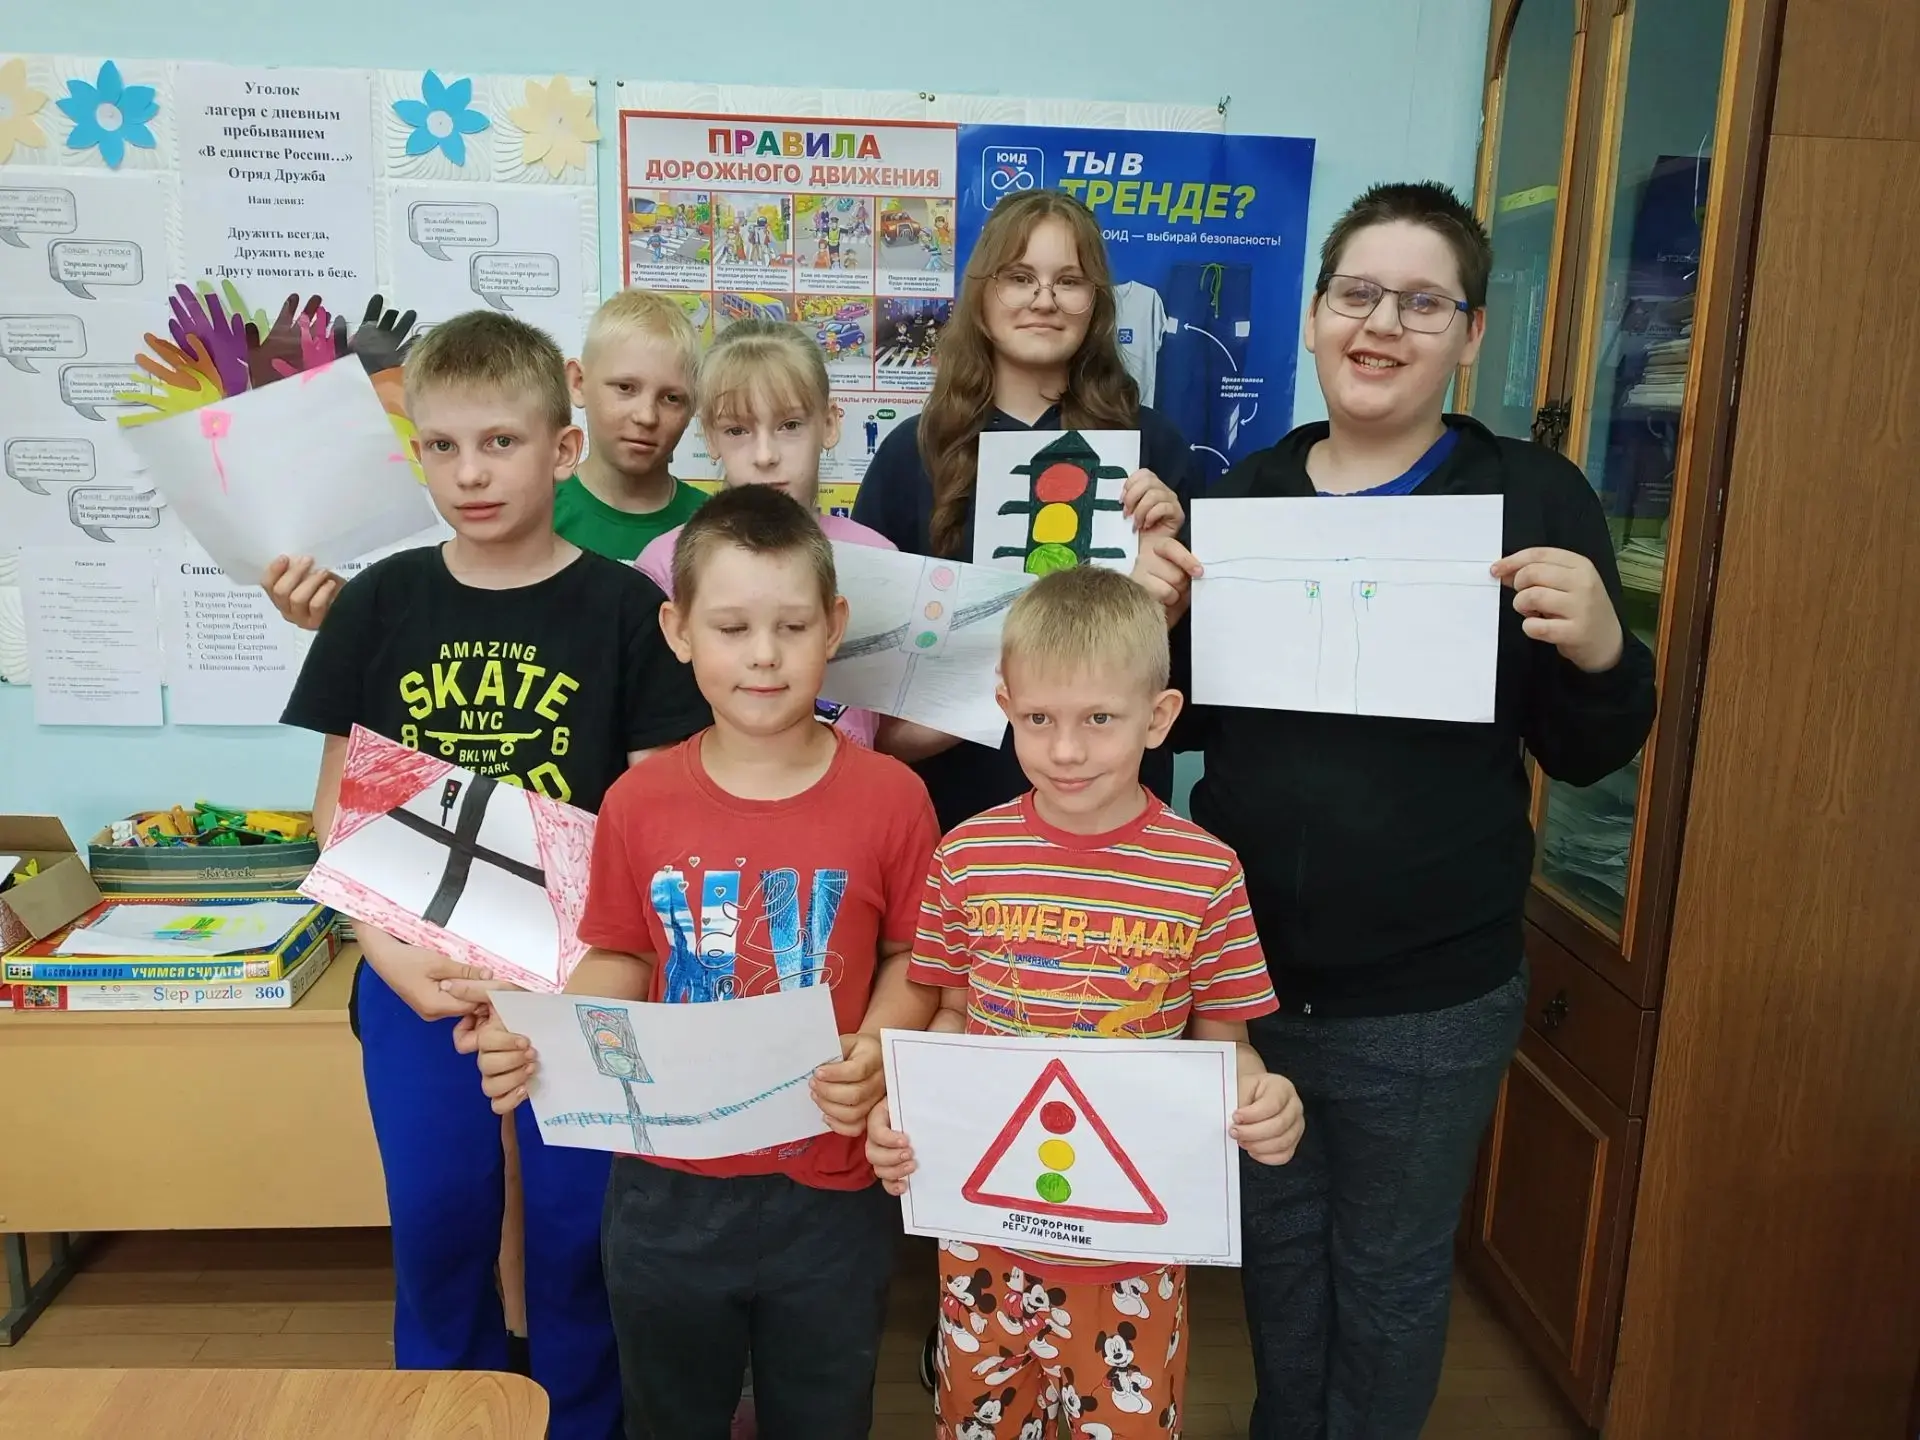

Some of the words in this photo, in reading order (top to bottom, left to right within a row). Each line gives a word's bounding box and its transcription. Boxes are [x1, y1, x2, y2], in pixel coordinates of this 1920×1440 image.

[244, 82, 300, 97] Уголок
[204, 105, 257, 121] лагеря
[260, 108, 269, 118] с
[272, 107, 341, 121] дневным
[222, 124, 325, 140] пребыванием
[708, 128, 881, 160] ПРАВИЛА
[198, 146, 216, 158] «В
[219, 147, 281, 160] единстве
[996, 152, 1028, 165] ЮИД
[1063, 150, 1116, 175] ТЫ
[1120, 153, 1144, 175] В
[228, 167, 272, 182] Отряд
[275, 169, 326, 184] Дружба
[645, 159, 801, 183] ДОРОЖНОГО
[808, 165, 940, 188] ДВИЖЕНИЯ
[248, 195, 271, 205] Наш
[273, 197, 305, 207] девиз:
[1059, 179, 1256, 224] ТРЕНДЕ?
[227, 226, 284, 241] Дружить
[287, 229, 330, 241] всегда,
[1146, 231, 1197, 243] выбирай
[1200, 232, 1281, 246] безопасность!
[97, 248, 131, 256] успеха
[234, 245, 291, 260] Дружить
[294, 248, 325, 260] везде
[205, 268, 213, 277] и
[216, 264, 253, 280] Другу
[256, 267, 314, 280] помогать
[318, 269, 326, 278] в
[327, 266, 358, 280] беде.
[180, 563, 225, 575] Списо
[439, 641, 537, 661] AMAZING
[400, 660, 580, 722] SKATE
[460, 710, 504, 731] NYC
[401, 724, 419, 752] 8
[551, 726, 570, 756] 6
[459, 749, 497, 763] BKLYN
[480, 761, 510, 775] PARK
[966, 899, 1088, 949] POWER
[1109, 916, 1199, 960] MAN
[131, 967, 185, 978] УЧИМСЯ
[187, 965, 242, 978] СЧИТАТЬ
[153, 986, 189, 1005] Step
[195, 985, 242, 1004] puzzle
[255, 986, 285, 999] 360
[1009, 1213, 1085, 1233] СВЕТОФОРНОЕ
[1002, 1221, 1092, 1245] РЕГУЛИРОВАНИЕ
